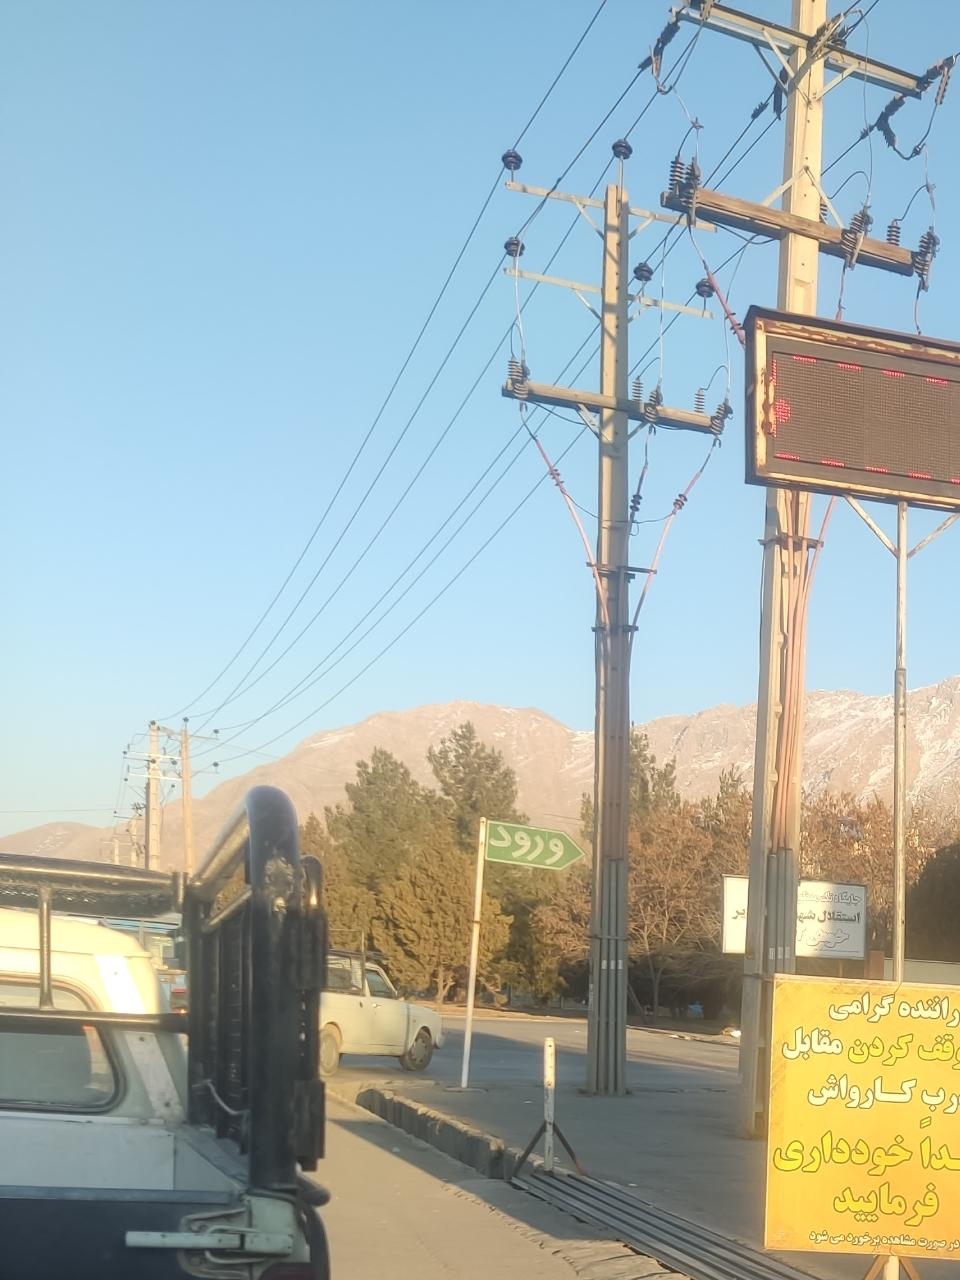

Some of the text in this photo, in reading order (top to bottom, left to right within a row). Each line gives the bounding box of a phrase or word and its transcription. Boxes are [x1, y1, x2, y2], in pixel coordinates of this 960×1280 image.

[489, 826, 564, 865] ورود
[818, 911, 860, 923] استقلال
[829, 992, 960, 1027] راننده گرامی
[782, 1028, 843, 1061] مقابل
[848, 1034, 913, 1066] کردن
[808, 1075, 918, 1109] کارواش
[774, 1131, 912, 1176] خودداری
[833, 1182, 940, 1226] فرمایید
[881, 1235, 915, 1246] مشاهده
[918, 1238, 946, 1249] صورت
[949, 1239, 960, 1252] در
